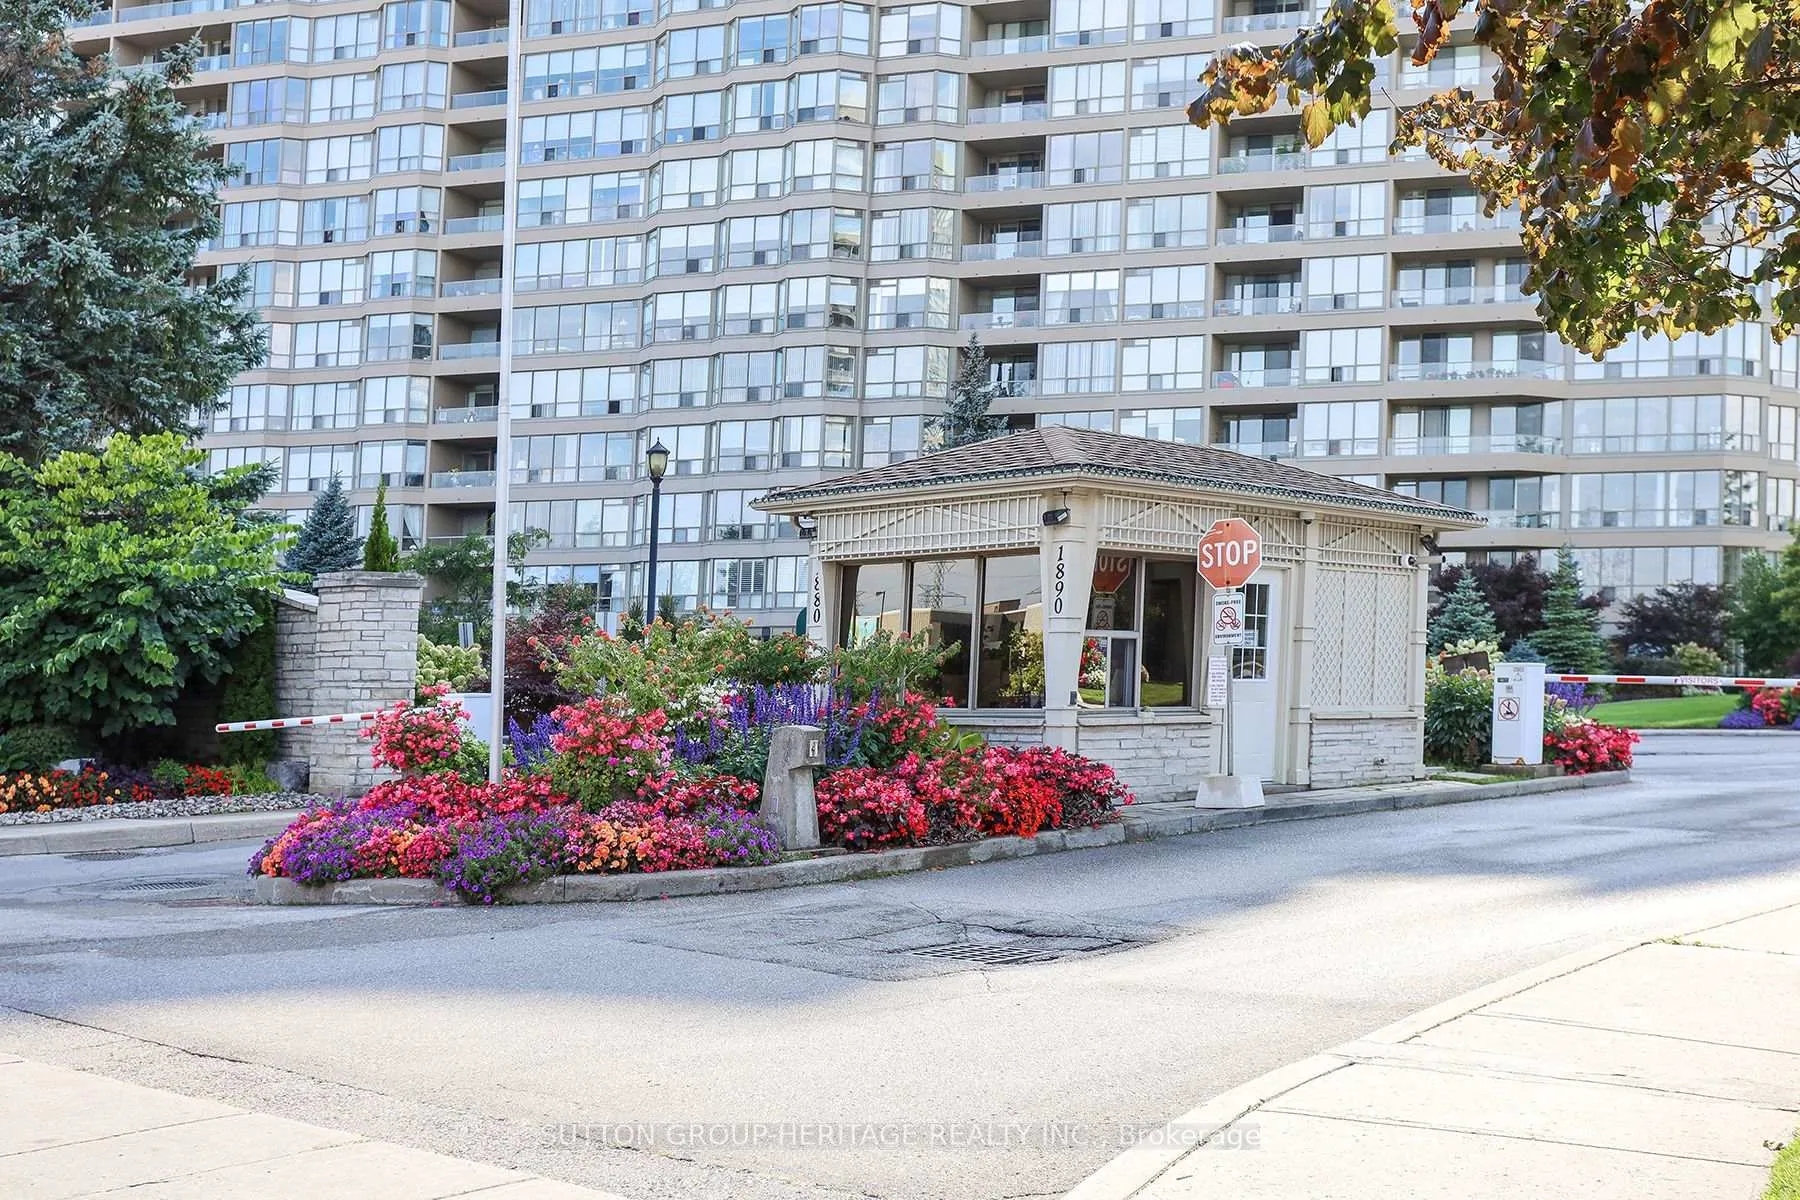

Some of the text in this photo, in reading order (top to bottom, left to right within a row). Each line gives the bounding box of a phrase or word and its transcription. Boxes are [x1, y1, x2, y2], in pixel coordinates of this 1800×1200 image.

[1201, 540, 1257, 568] STOP
[1054, 545, 1065, 614] 1890
[1680, 676, 1719, 685] VISITORS
